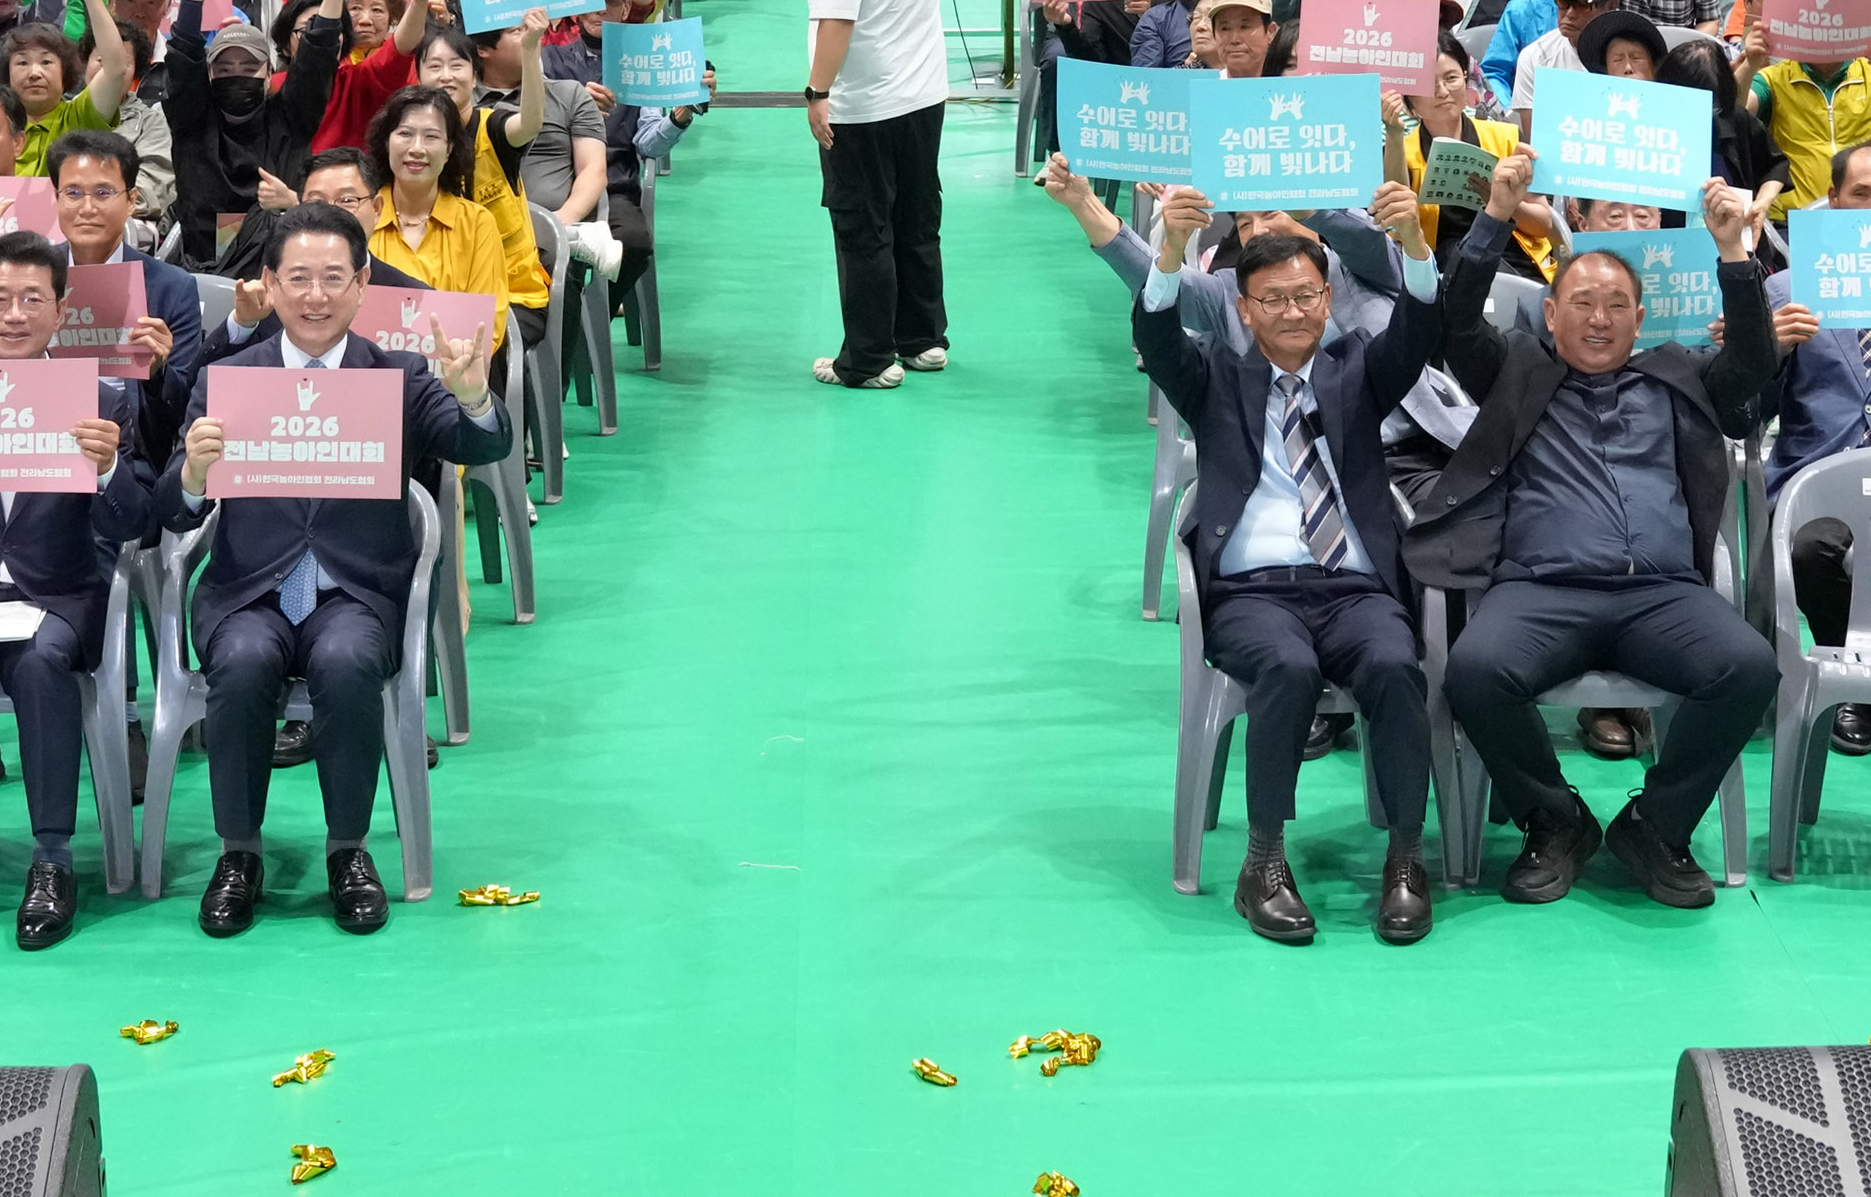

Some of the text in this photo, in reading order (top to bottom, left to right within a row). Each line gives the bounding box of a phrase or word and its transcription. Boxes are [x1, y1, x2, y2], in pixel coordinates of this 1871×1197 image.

[1344, 28, 1393, 47] 2026
[1310, 44, 1424, 69] 전남농아인대회
[1219, 123, 1356, 150] 수어로 잇다,
[1557, 115, 1686, 153] 수어로 잇다,
[1223, 150, 1352, 177] 함께 빛나다
[1560, 140, 1682, 176] 함께 빛나다
[1818, 275, 1863, 297] 함께
[270, 415, 339, 438] 2026
[223, 440, 384, 464] 전남농아인대회
[20, 467, 72, 478] 전라남도협회
[247, 474, 376, 486] (사)한국농아인협회 전라남도협회
